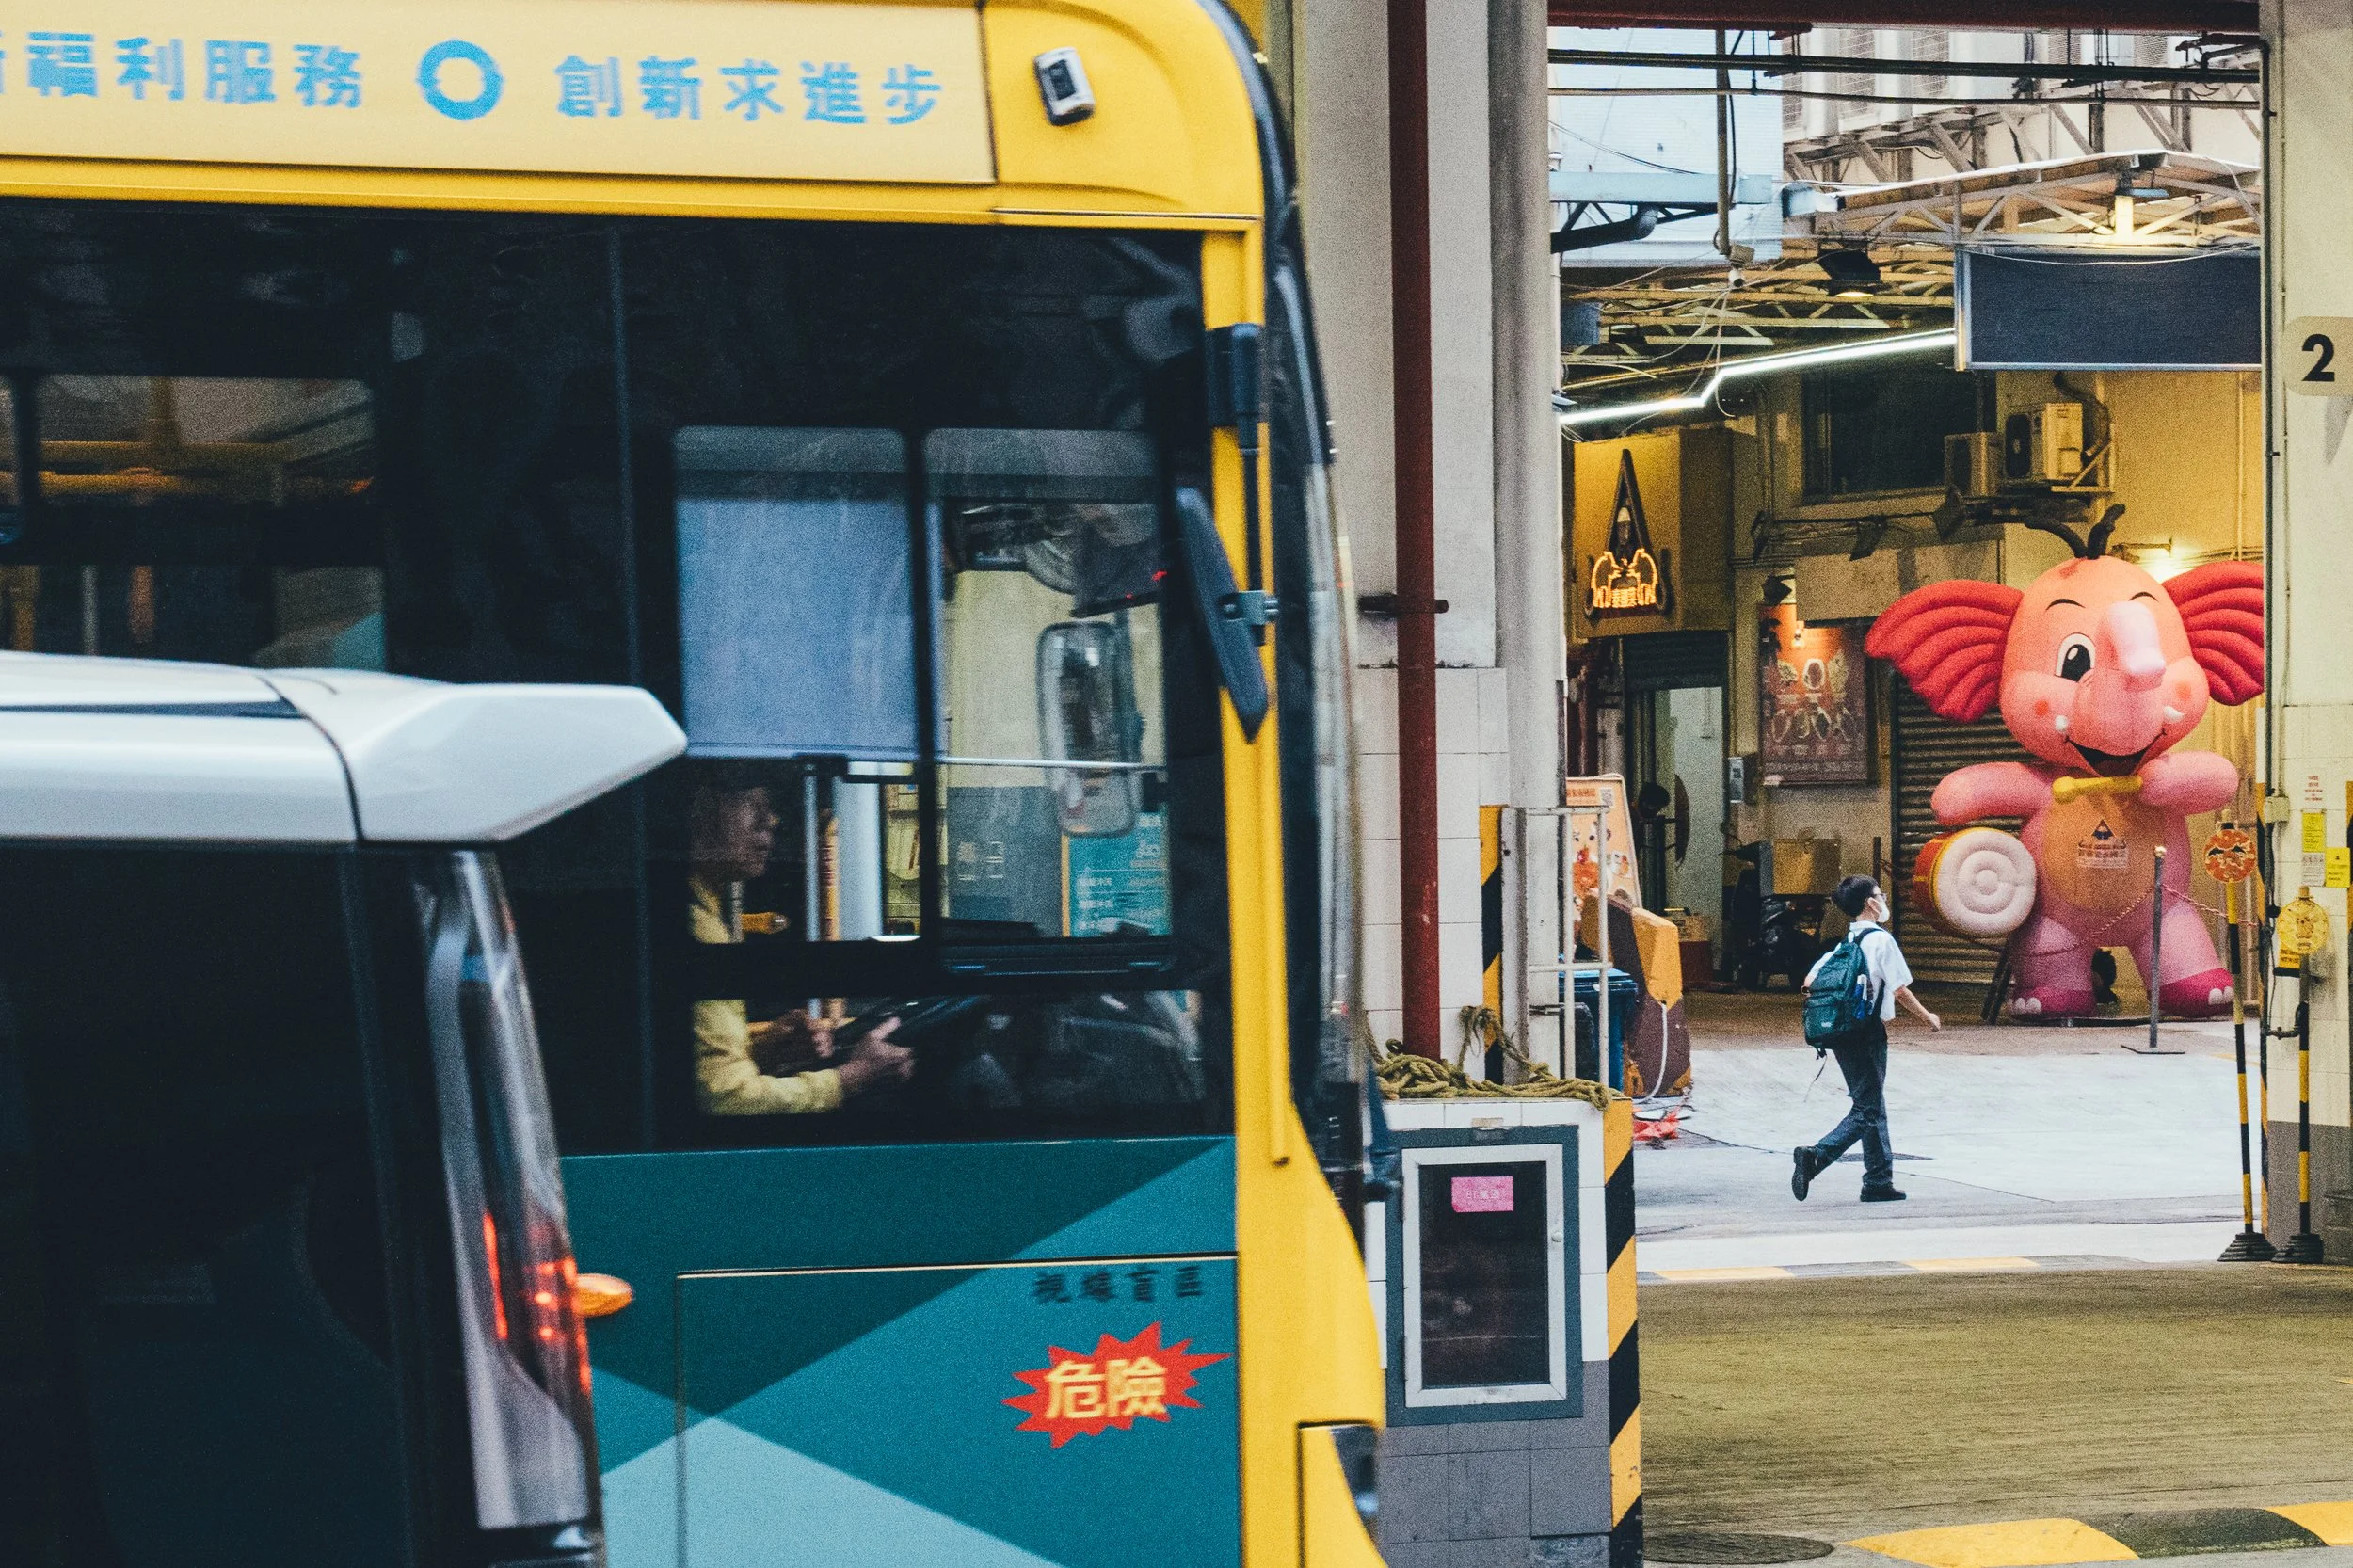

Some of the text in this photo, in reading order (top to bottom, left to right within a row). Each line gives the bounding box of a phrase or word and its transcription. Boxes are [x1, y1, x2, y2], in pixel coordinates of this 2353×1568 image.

[0, 31, 942, 124] 福利服務 創新求進步
[2301, 333, 2335, 382] 2
[1044, 1355, 1167, 1418] 危險
